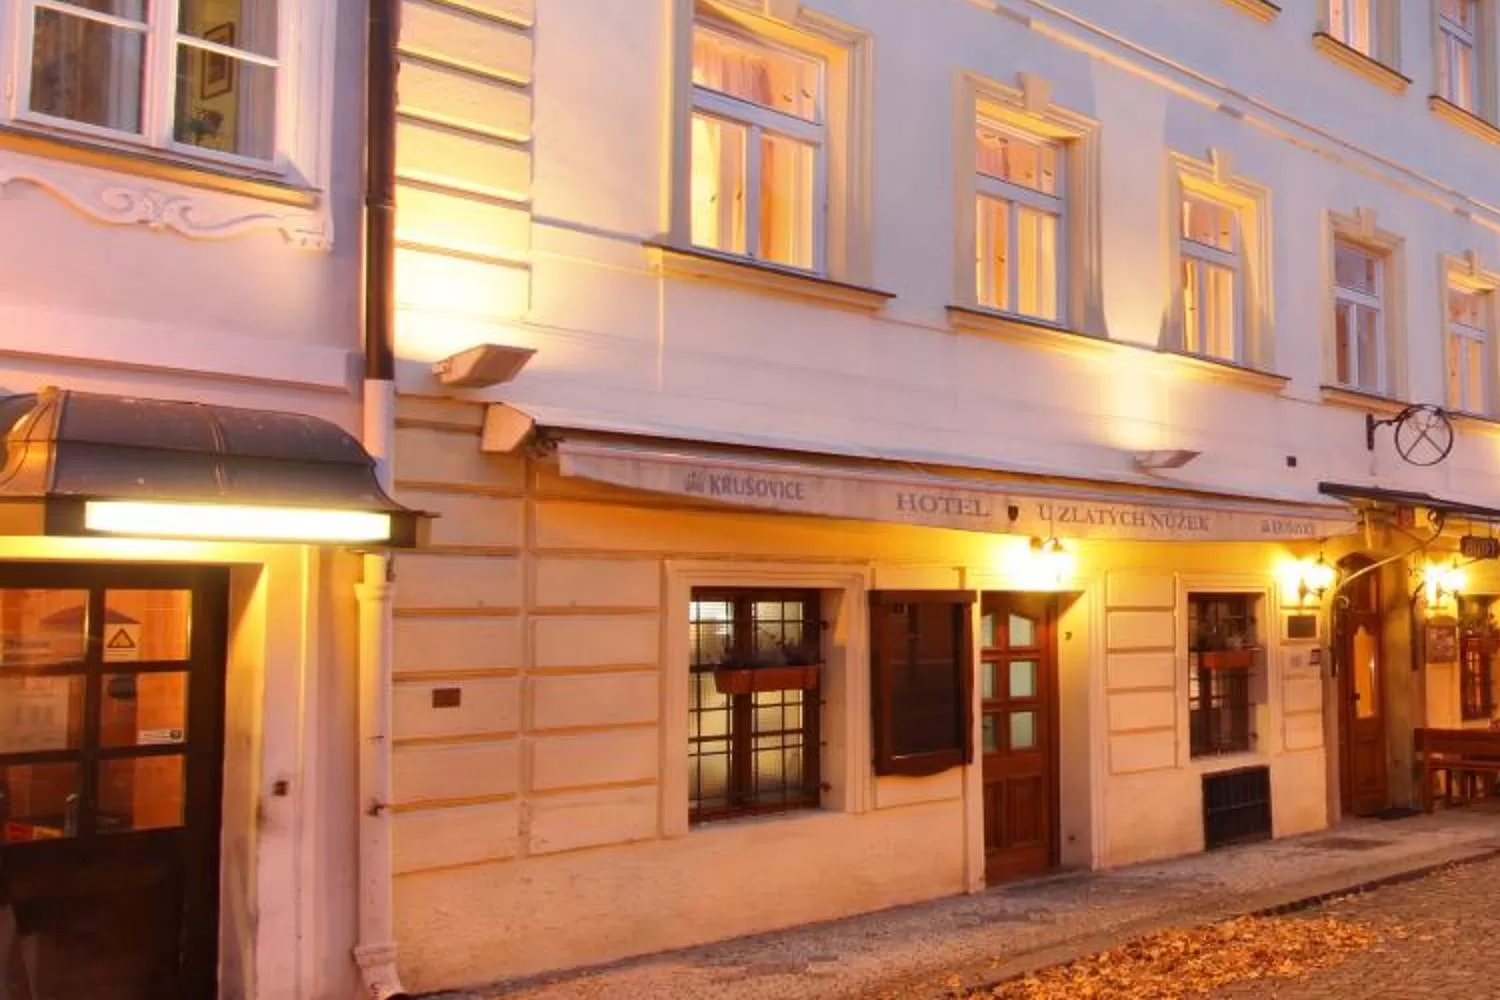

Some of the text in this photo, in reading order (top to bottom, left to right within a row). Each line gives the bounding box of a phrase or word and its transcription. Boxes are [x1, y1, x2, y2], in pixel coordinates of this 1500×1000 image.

[709, 472, 805, 500] KRUŠOVICE
[896, 492, 992, 517] HOTEL
[1038, 503, 1053, 521] U
[1057, 505, 1146, 527] ZLATÝCH
